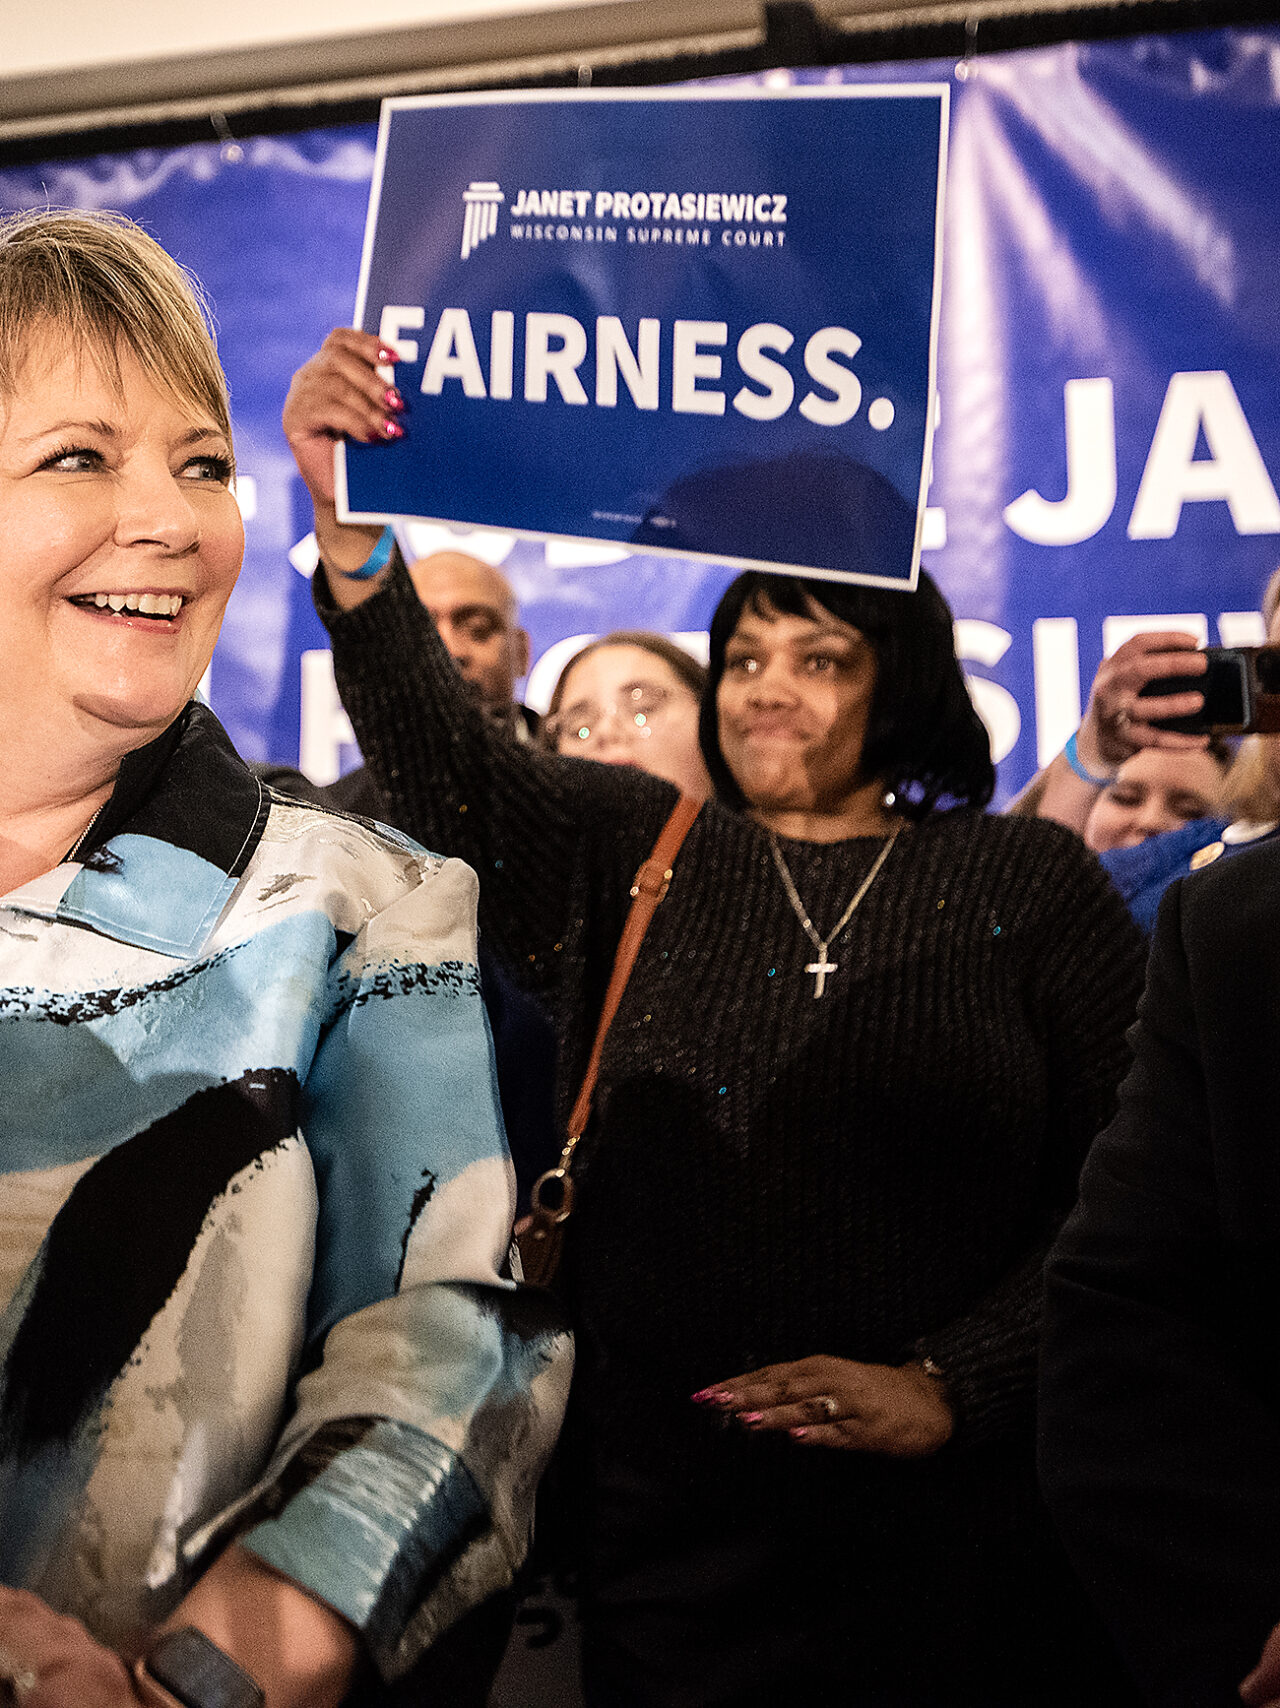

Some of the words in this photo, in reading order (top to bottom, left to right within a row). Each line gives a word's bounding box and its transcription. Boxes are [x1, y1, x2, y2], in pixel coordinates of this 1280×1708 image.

[510, 189, 592, 219] JANET
[595, 191, 788, 222] PROTASIEWICZ
[509, 223, 618, 243] WISCONSIN
[626, 226, 711, 246] SUPREME
[720, 229, 787, 248] COURT
[376, 304, 896, 432] FAIRNESS.
